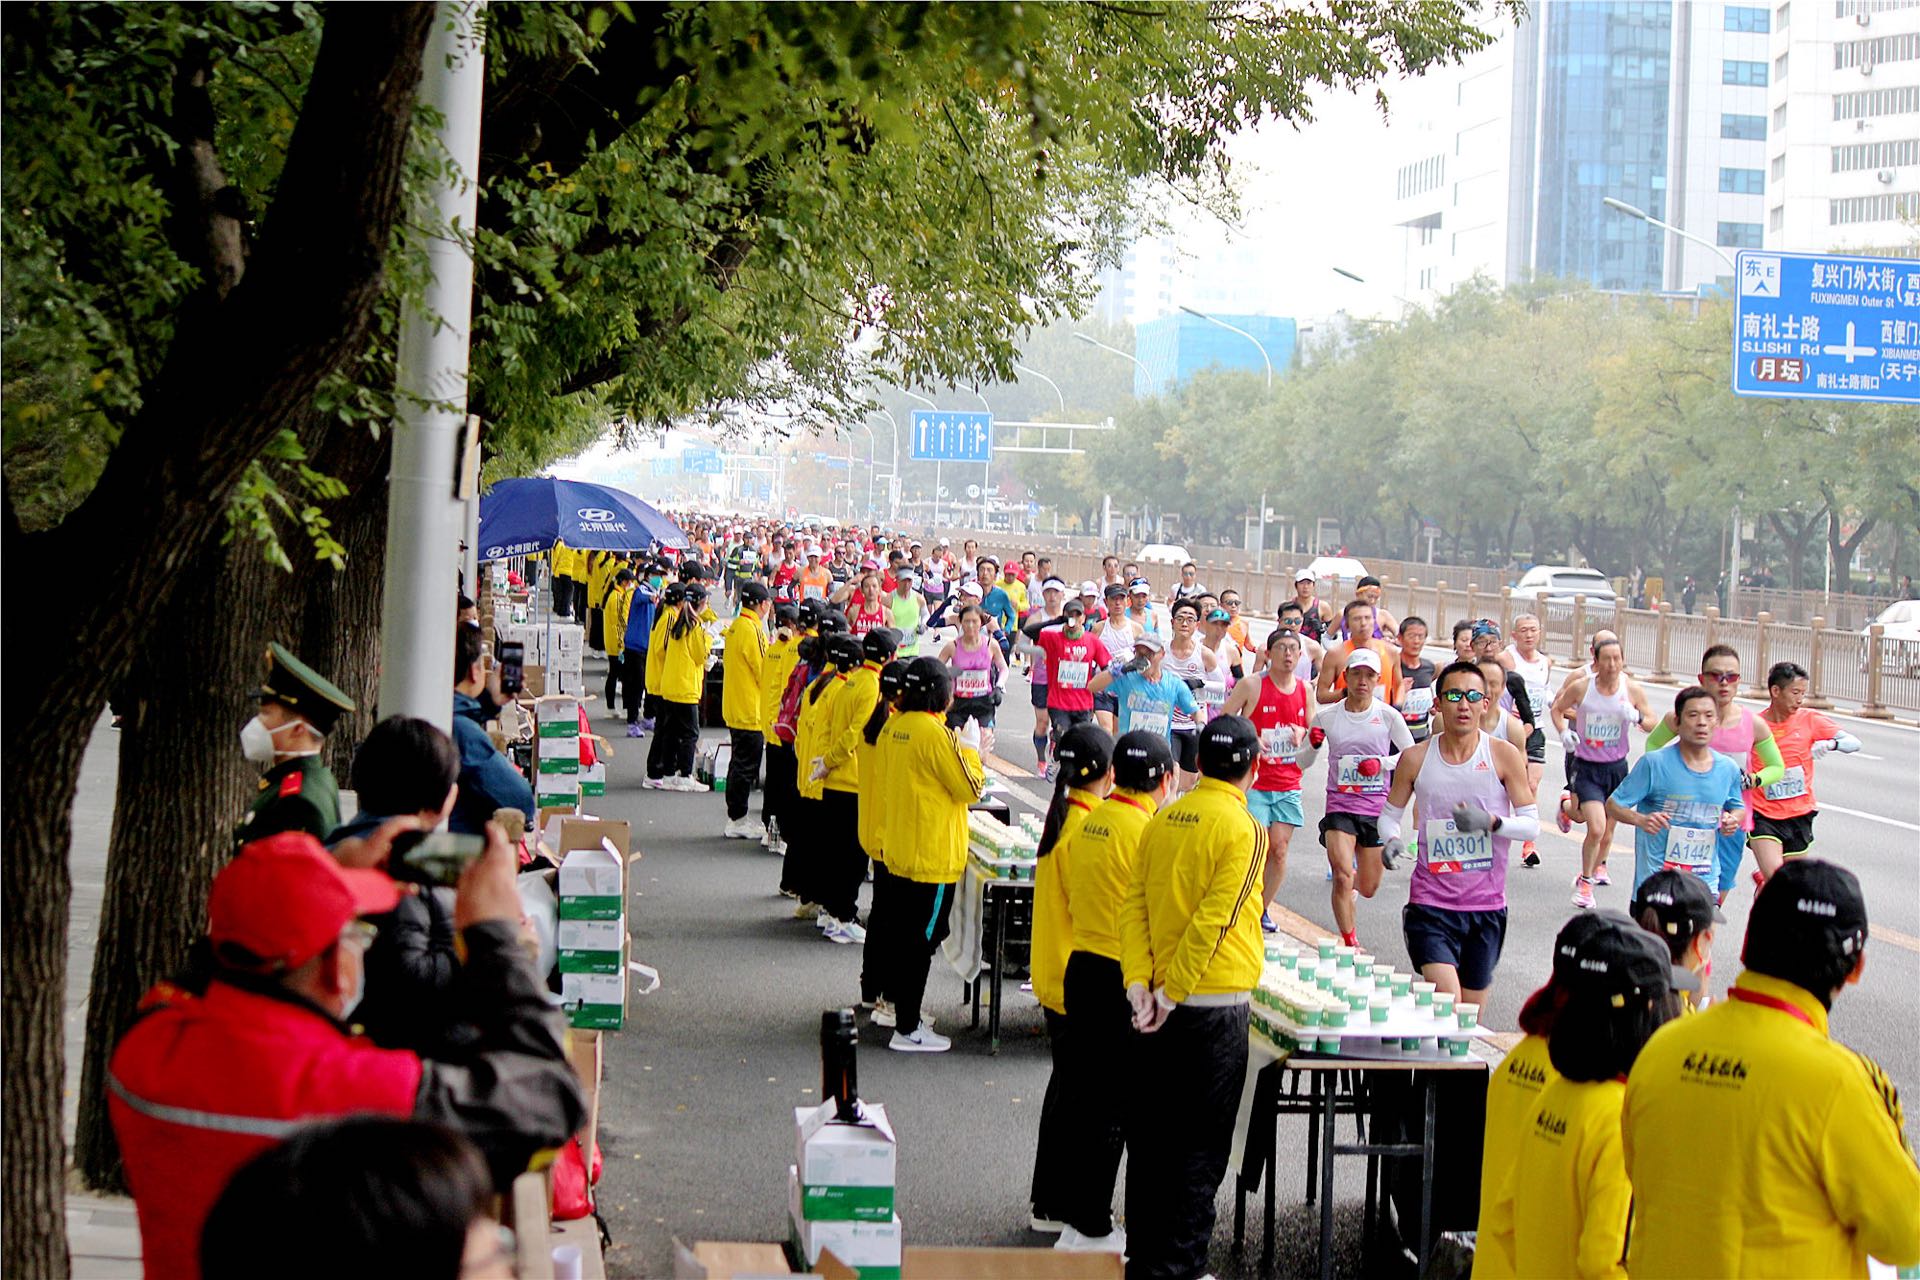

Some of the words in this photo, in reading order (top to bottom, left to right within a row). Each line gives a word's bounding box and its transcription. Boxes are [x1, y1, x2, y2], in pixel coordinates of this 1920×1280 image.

[1745, 259, 1761, 277] 东
[1767, 266, 1775, 278] E
[1811, 262, 1896, 292] 复兴门外大街
[1810, 292, 1859, 306] FUXINGMEN
[1861, 295, 1883, 308] Outer
[1886, 296, 1895, 309] St
[1743, 313, 1820, 342] 南礼士路
[1881, 319, 1920, 346] 西便门
[1742, 341, 1791, 355] S.LISHI
[1800, 343, 1820, 356] Rd
[1817, 371, 1880, 390] 南礼士路南口
[1880, 363, 1920, 382] (天宁
[1432, 835, 1486, 857] A0301
[1669, 841, 1711, 860] A1442
